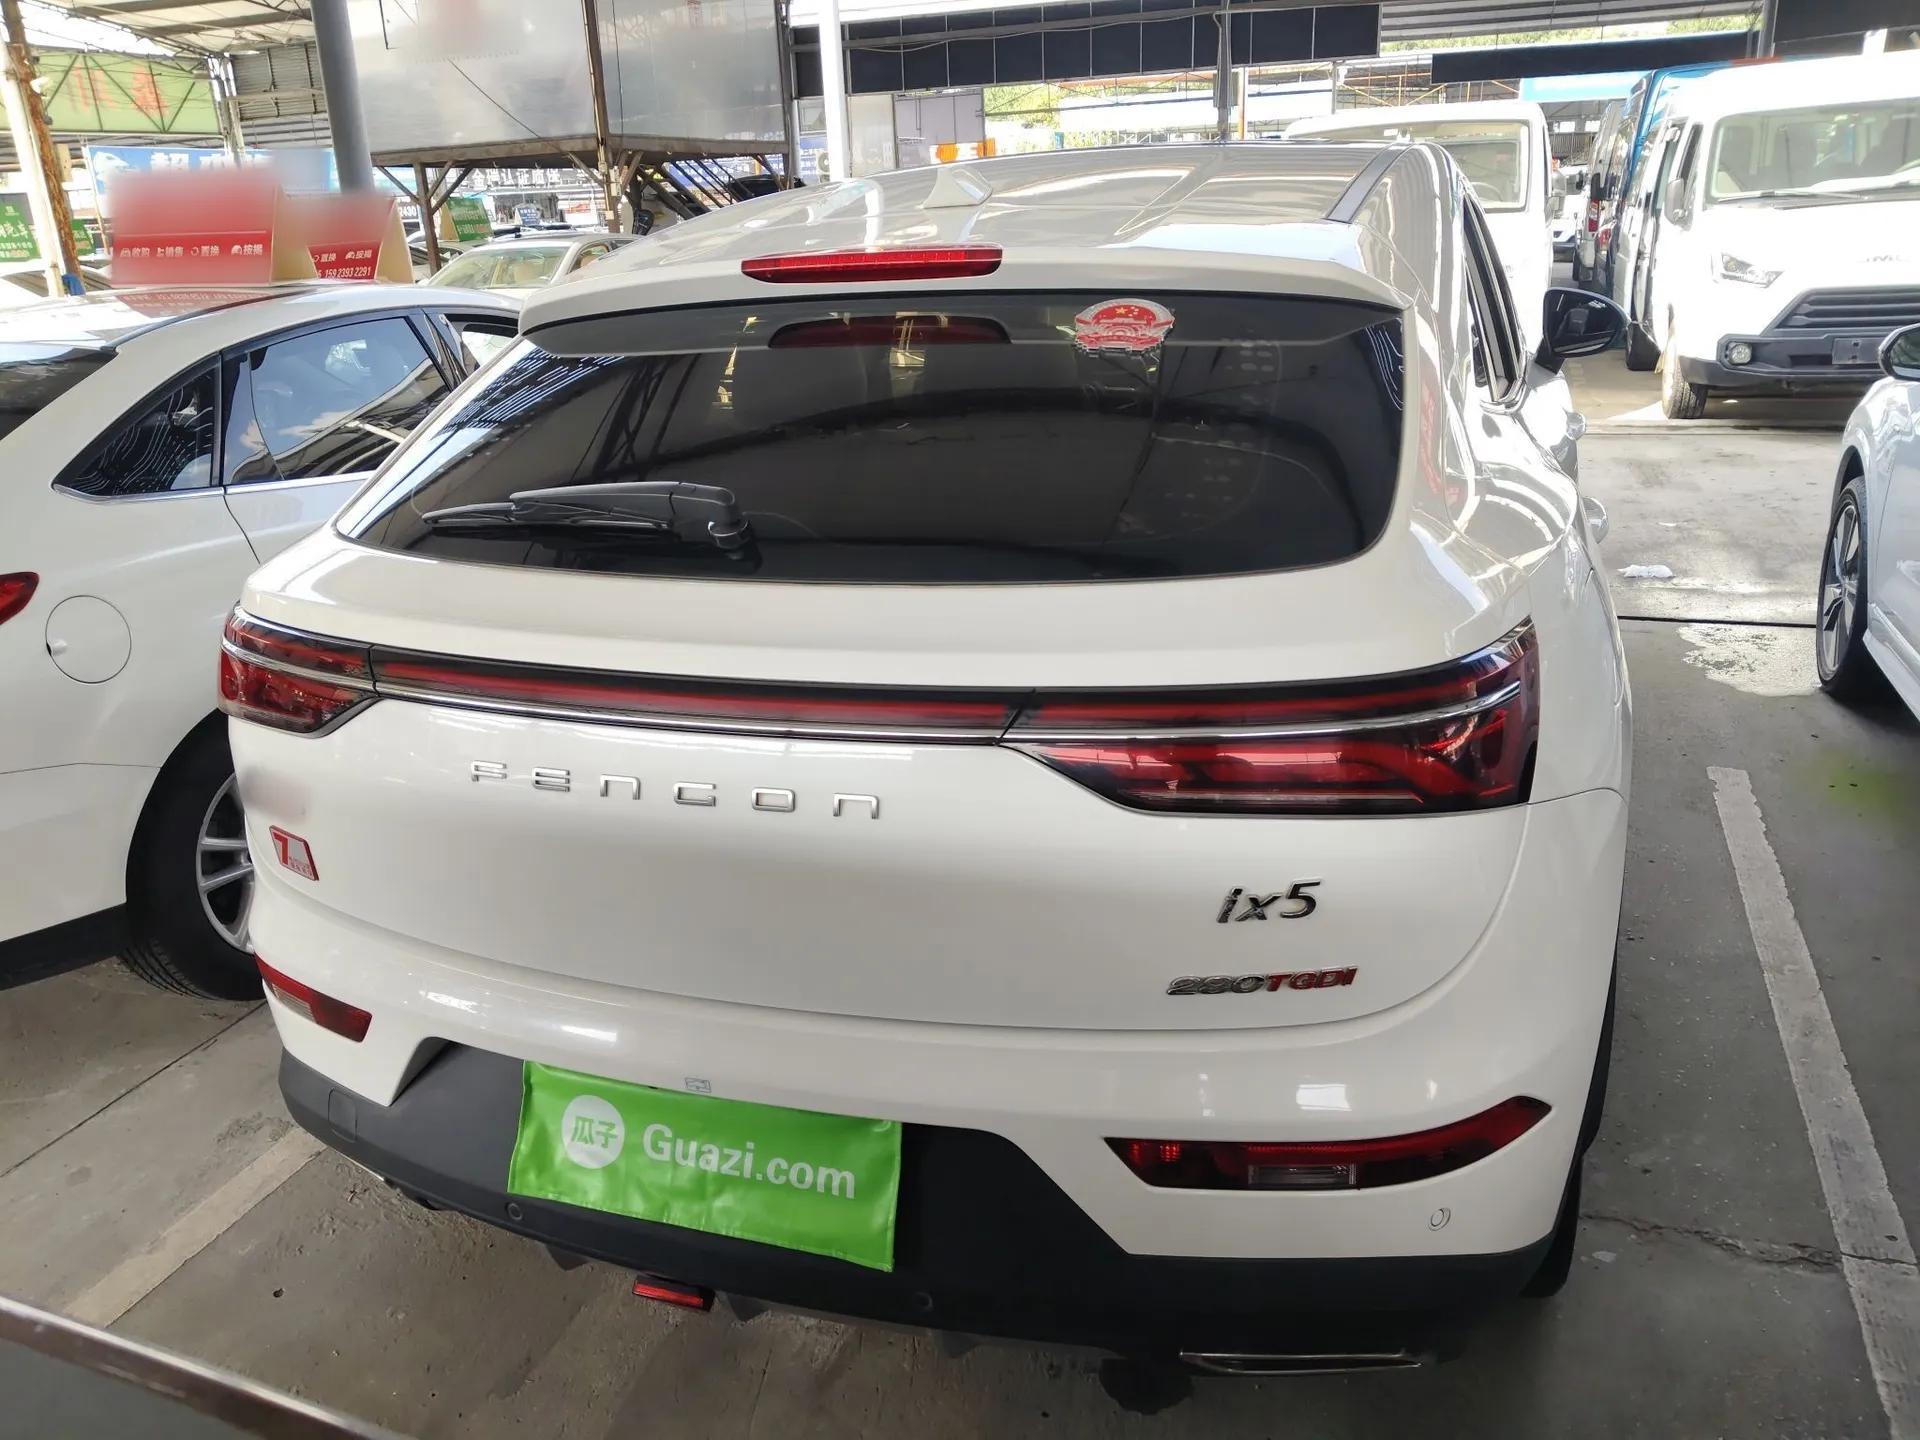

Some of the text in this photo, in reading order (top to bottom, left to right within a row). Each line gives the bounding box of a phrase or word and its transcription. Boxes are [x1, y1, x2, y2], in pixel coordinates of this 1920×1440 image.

[1216, 877, 1322, 923] ix5
[571, 1116, 856, 1200] 瓜子 Guazi.com
